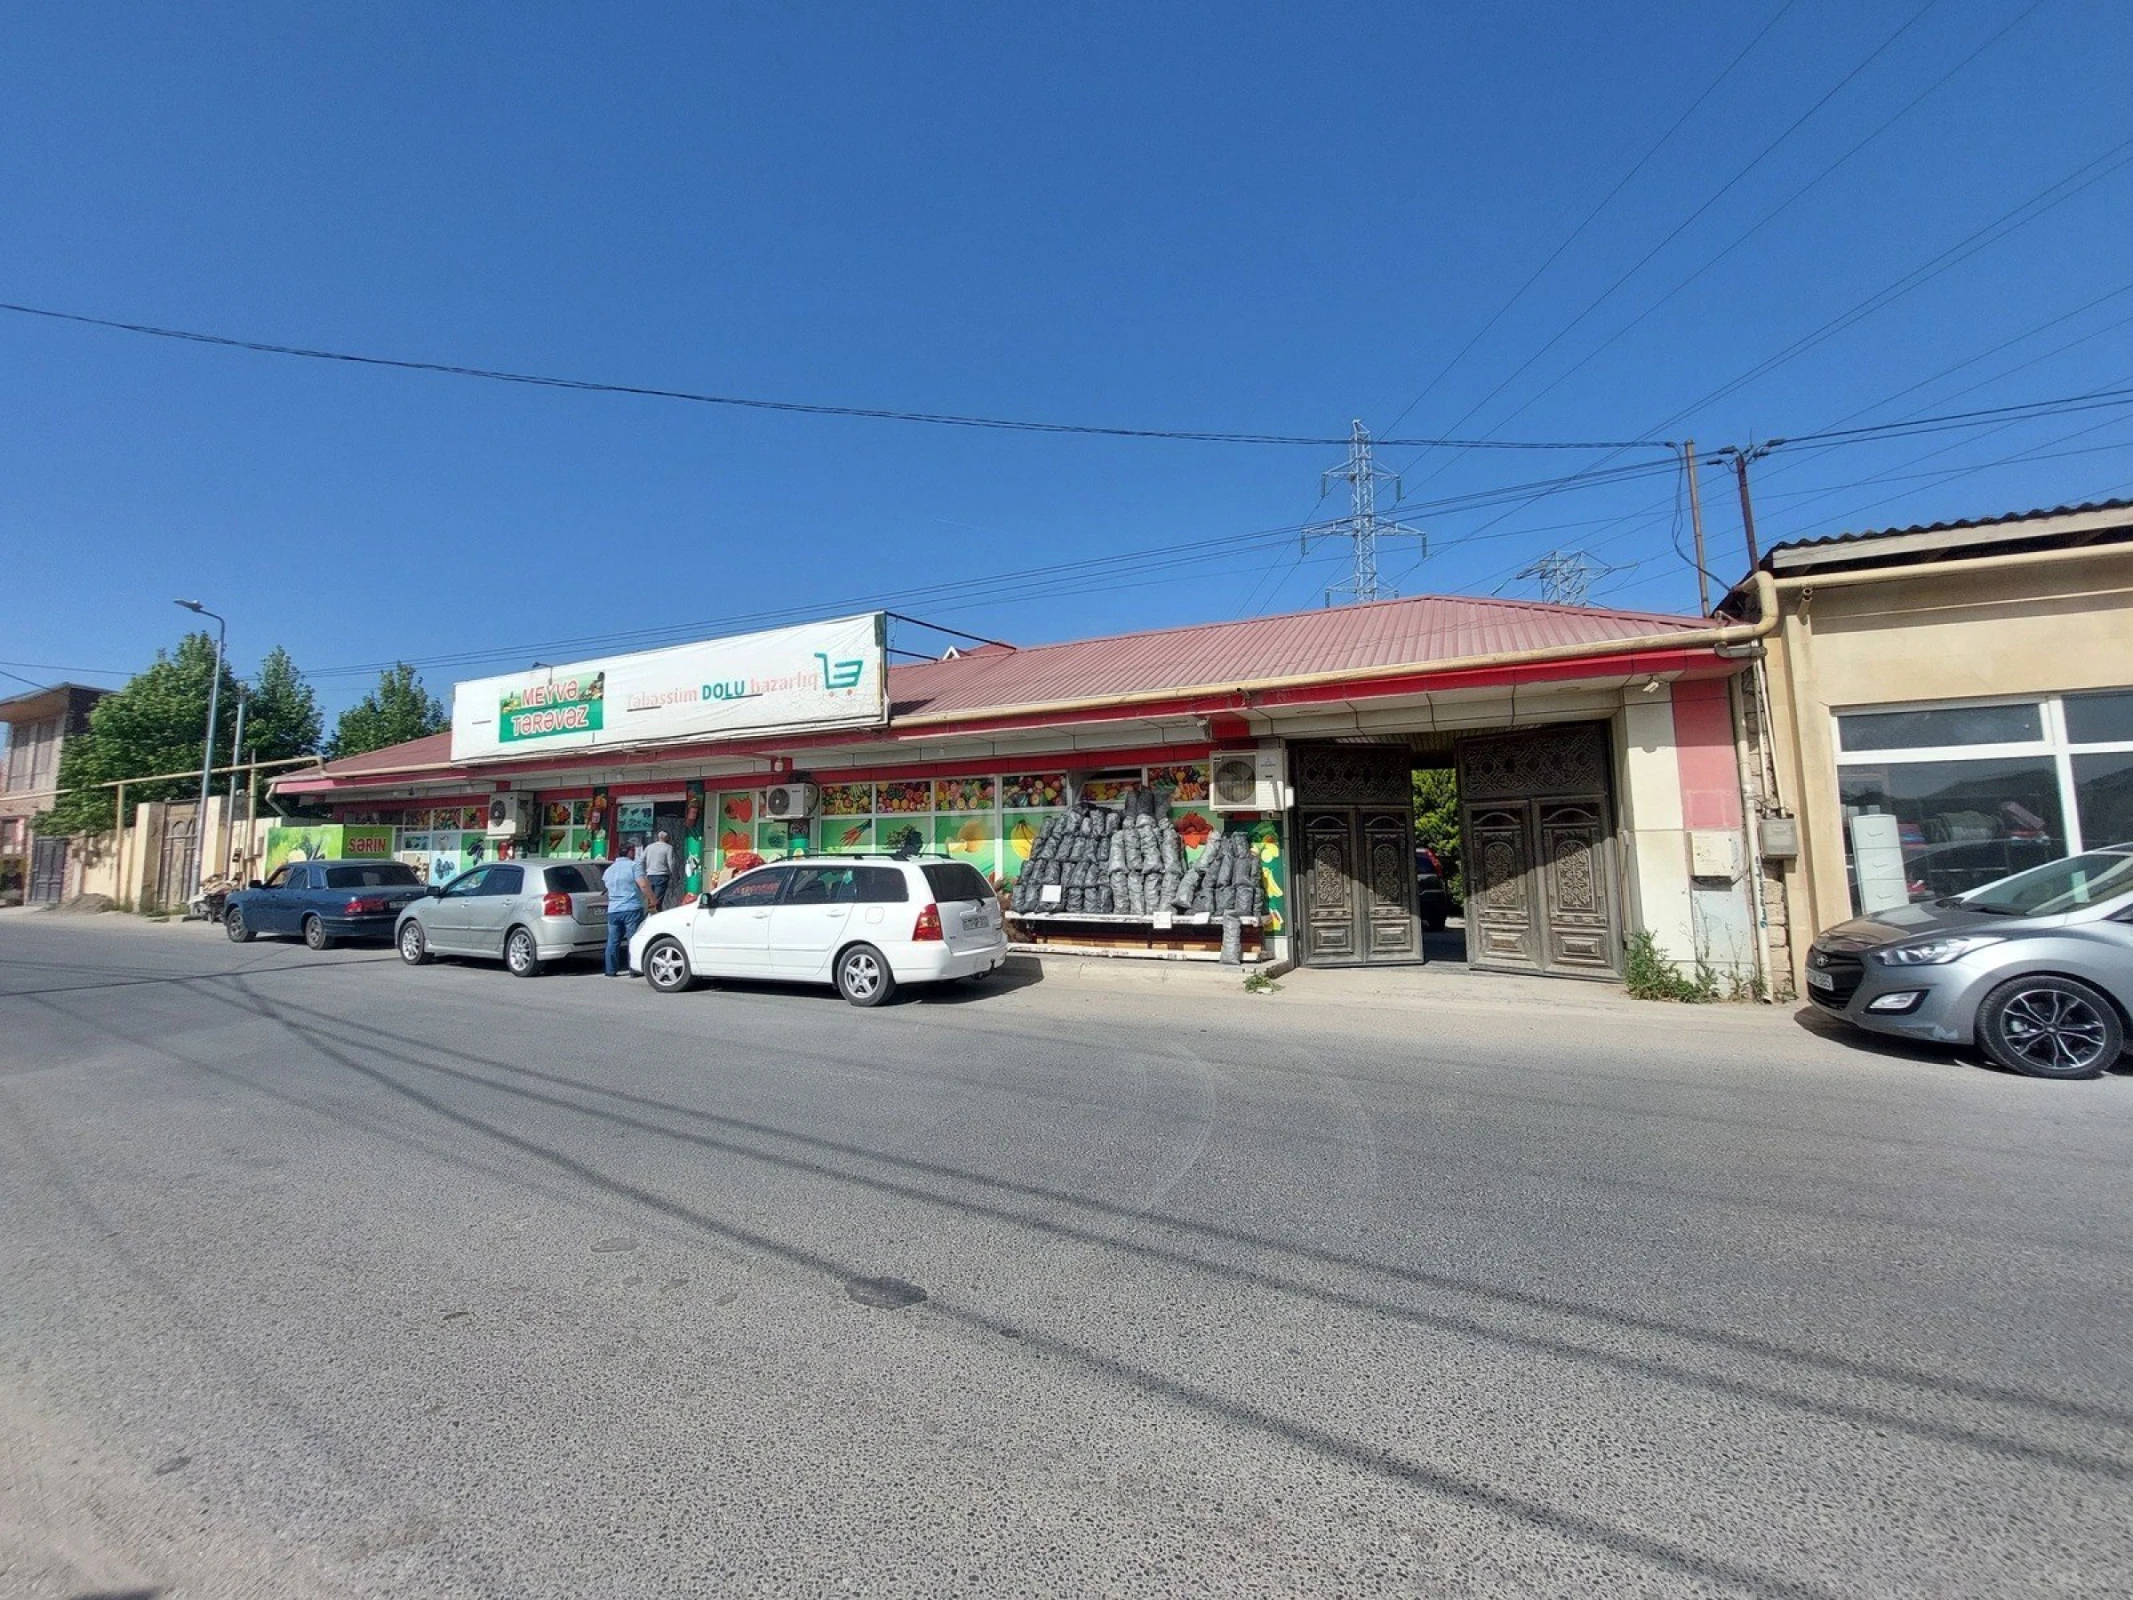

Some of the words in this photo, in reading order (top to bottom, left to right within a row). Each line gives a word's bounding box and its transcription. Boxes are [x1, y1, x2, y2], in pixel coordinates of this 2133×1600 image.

[522, 679, 579, 706] MEYVƏ
[702, 680, 745, 699] DOLU
[750, 671, 818, 693] bazarlıq
[511, 705, 589, 736] TƏRƏVƏZ
